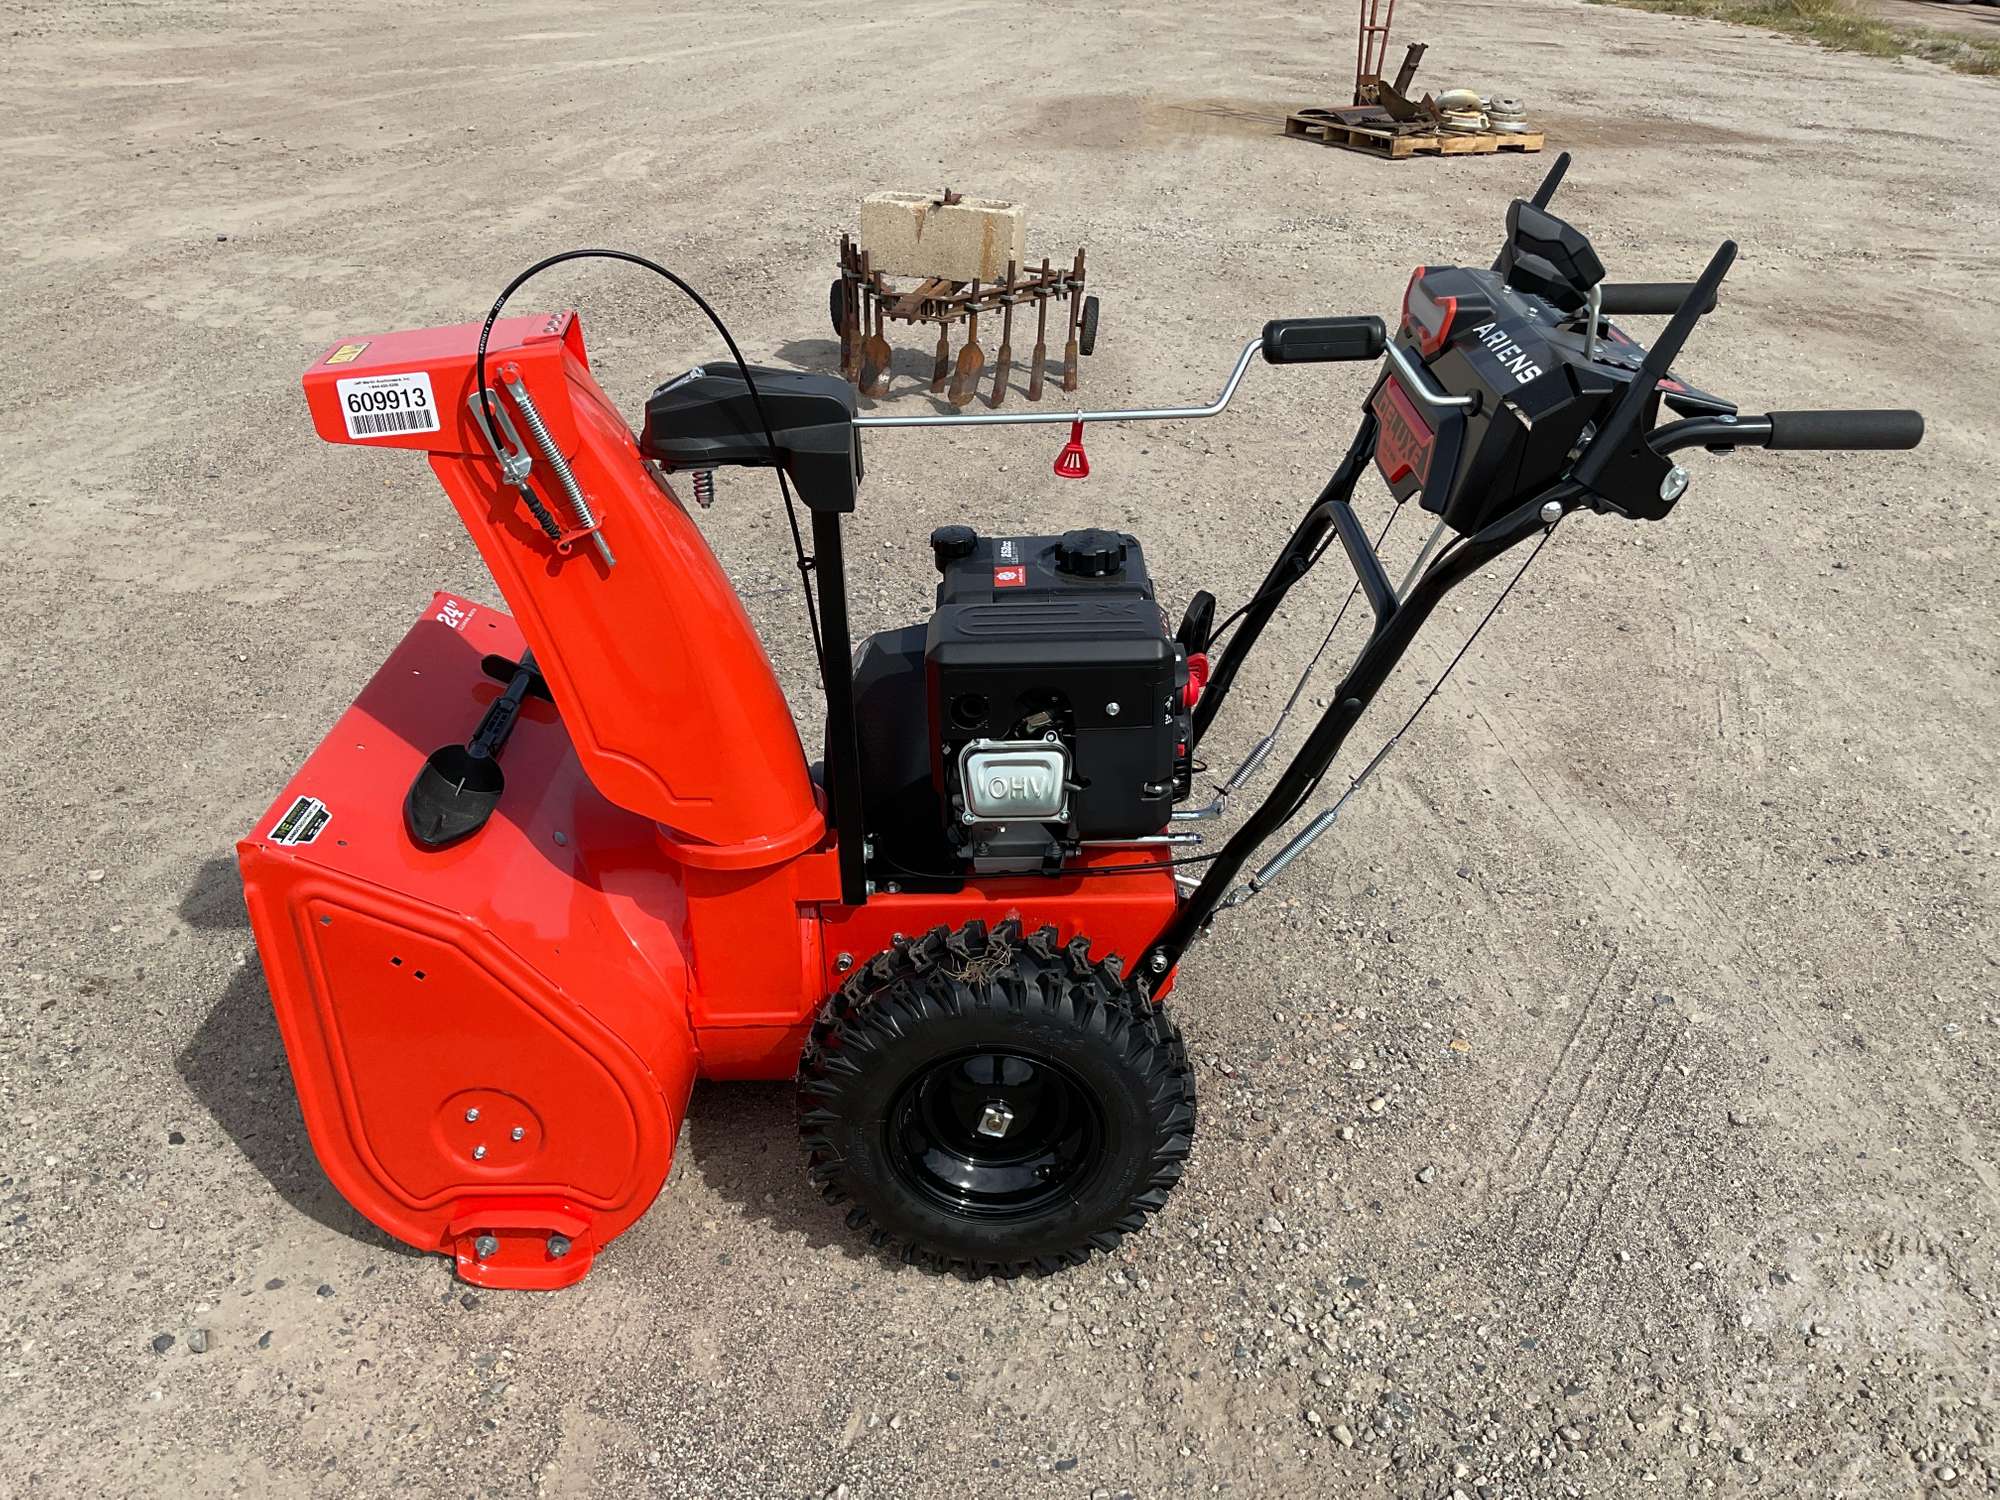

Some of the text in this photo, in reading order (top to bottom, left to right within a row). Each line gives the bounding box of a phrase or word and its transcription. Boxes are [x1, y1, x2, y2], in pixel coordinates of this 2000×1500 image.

[1472, 322, 1543, 385] ARIENS
[347, 387, 427, 413] 609913
[436, 599, 465, 629] 24"
[988, 776, 1044, 800] OHV
